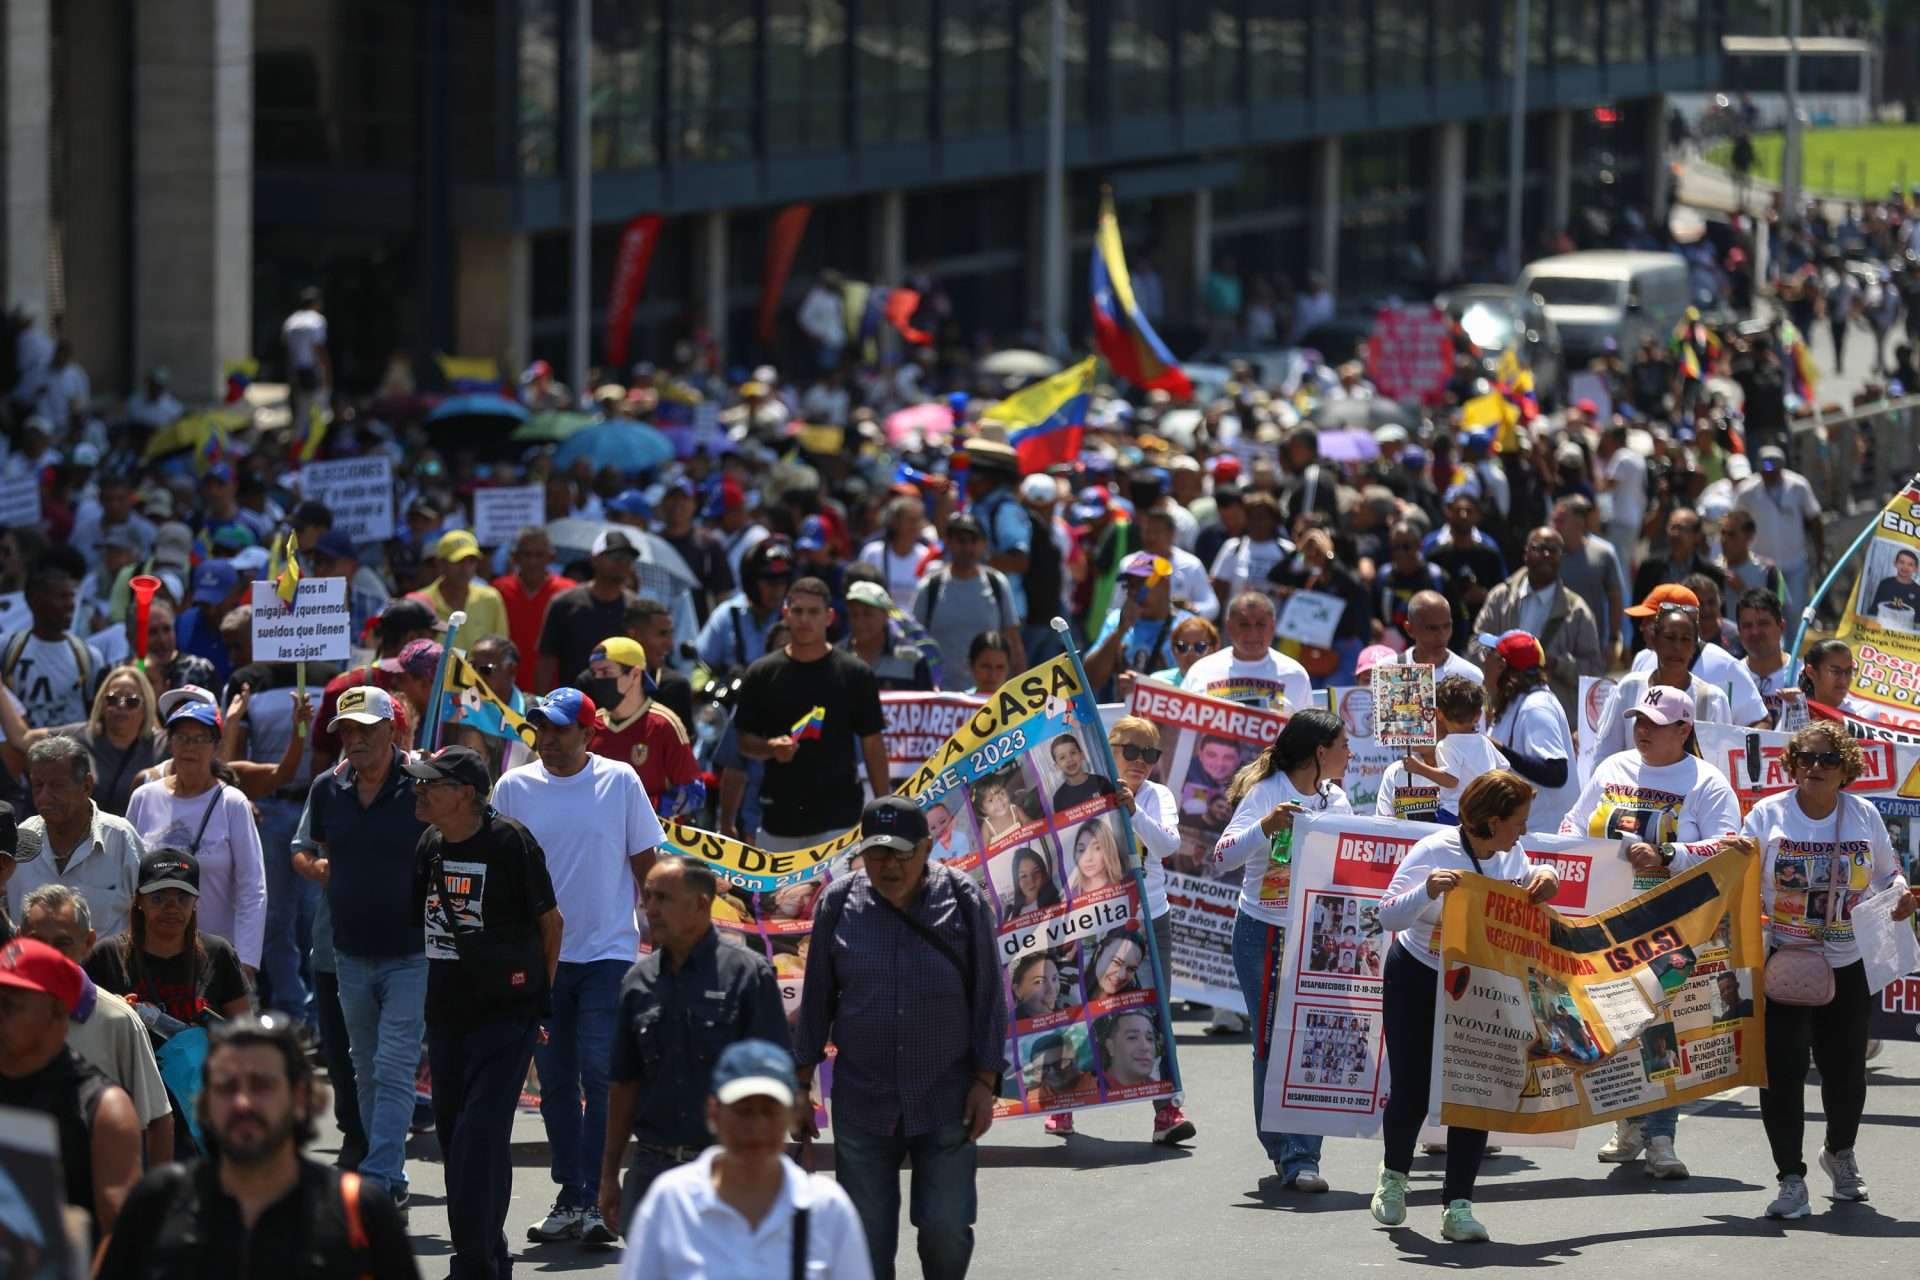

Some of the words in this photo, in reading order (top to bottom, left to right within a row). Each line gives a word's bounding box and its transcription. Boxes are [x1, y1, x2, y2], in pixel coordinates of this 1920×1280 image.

[1882, 511, 1920, 541] En
[257, 625, 295, 639] sueldos
[296, 626, 314, 639] que
[315, 623, 345, 636] llenen
[279, 646, 293, 659] las
[1861, 663, 1885, 681] la
[1889, 671, 1920, 692] Isl
[969, 728, 1028, 775] 2023
[738, 844, 795, 874] DE
[943, 737, 965, 766] A
[971, 664, 1078, 739] CASA
[1341, 838, 1408, 866] DESAPA
[1780, 839, 1870, 854] AYUDANOS
[1171, 908, 1187, 922] 29
[1188, 912, 1218, 929] años
[1003, 933, 1037, 956] de
[1046, 903, 1129, 942] vuelta
[1300, 980, 1346, 992] DESAPARECIDOS
[1673, 1004, 1712, 1018] ESCUCHADOS
[1444, 1013, 1535, 1042] ENCONTRARLOS
[1463, 1071, 1475, 1082] de
[1476, 1073, 1492, 1085] San
[1541, 1068, 1551, 1081] NO
[1451, 1082, 1493, 1098] Colombia
[1541, 1087, 1551, 1098] DE
[1287, 1093, 1332, 1104] DESAPARECIDOS
